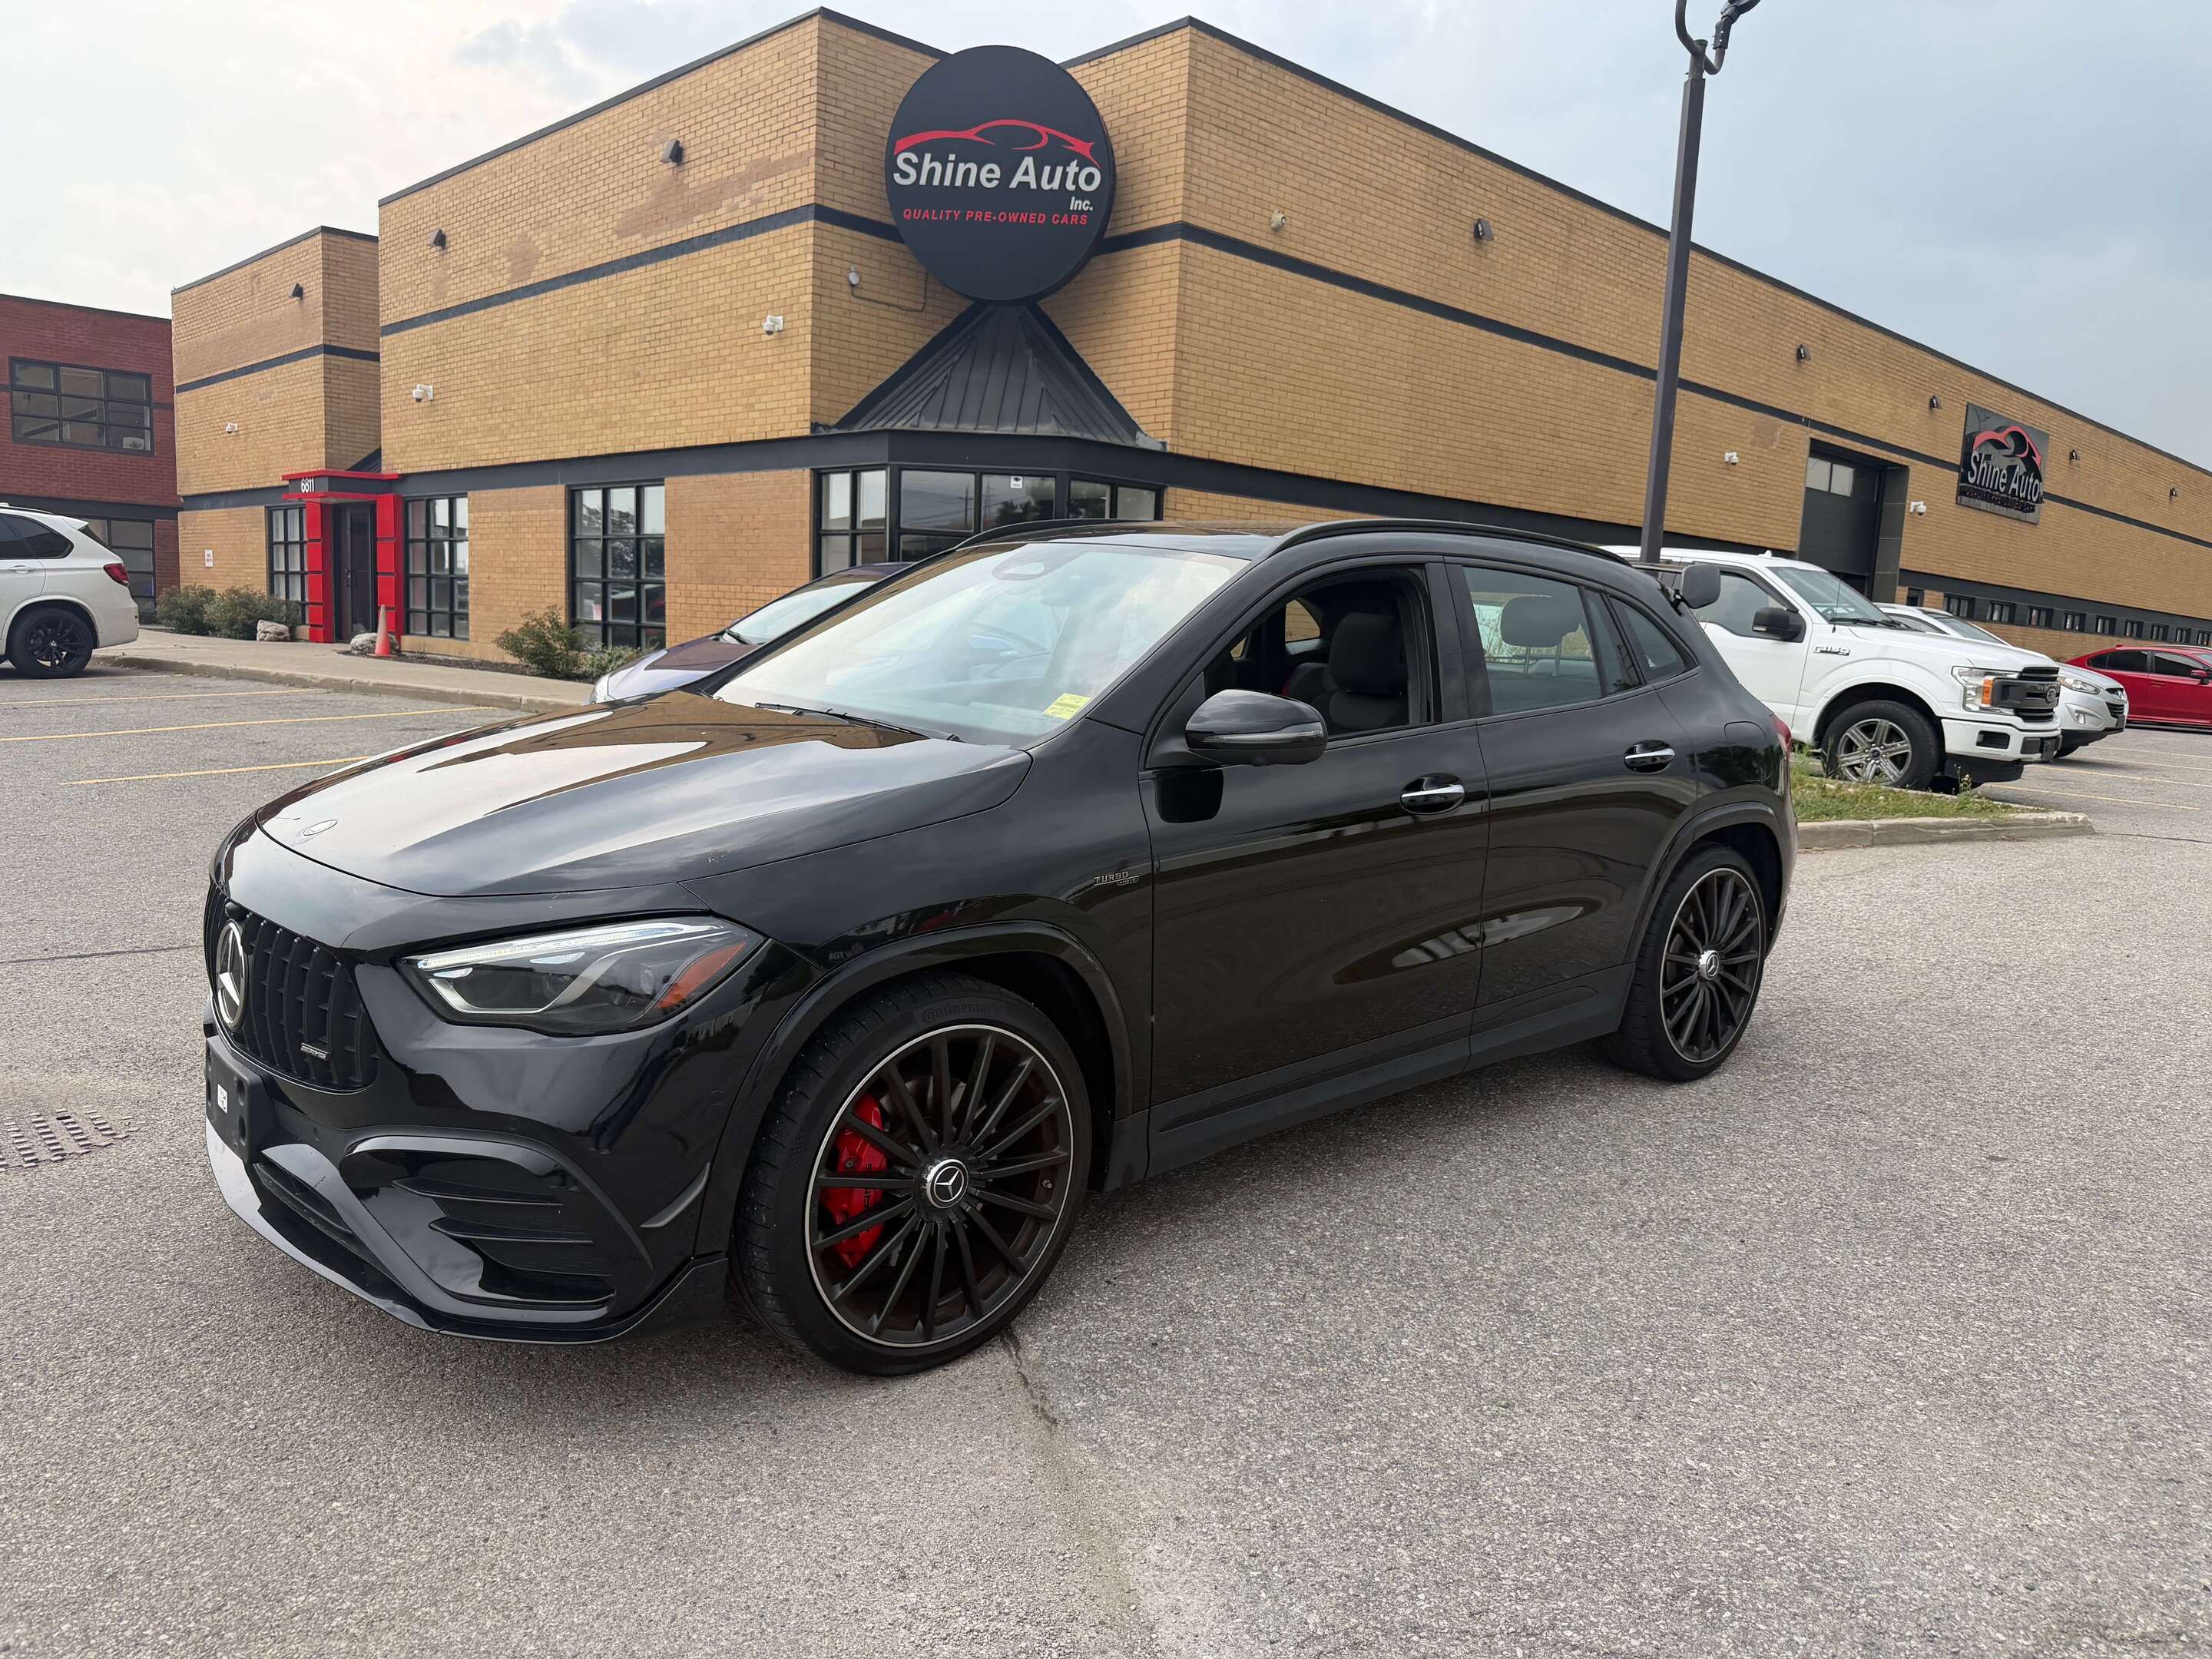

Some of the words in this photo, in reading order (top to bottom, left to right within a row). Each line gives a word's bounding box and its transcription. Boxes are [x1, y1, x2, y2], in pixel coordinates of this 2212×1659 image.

[893, 152, 1001, 188] Shine
[1008, 157, 1101, 191] Auto
[1069, 197, 1093, 211] Inc.
[903, 209, 961, 221] QUALITY
[965, 211, 1046, 224] PRE-OWNED
[1051, 214, 1088, 225] CARS
[1968, 450, 2008, 492] Shine
[2008, 465, 2040, 502] Auto
[301, 477, 314, 493] 6811
[1094, 871, 1128, 884] TURBO
